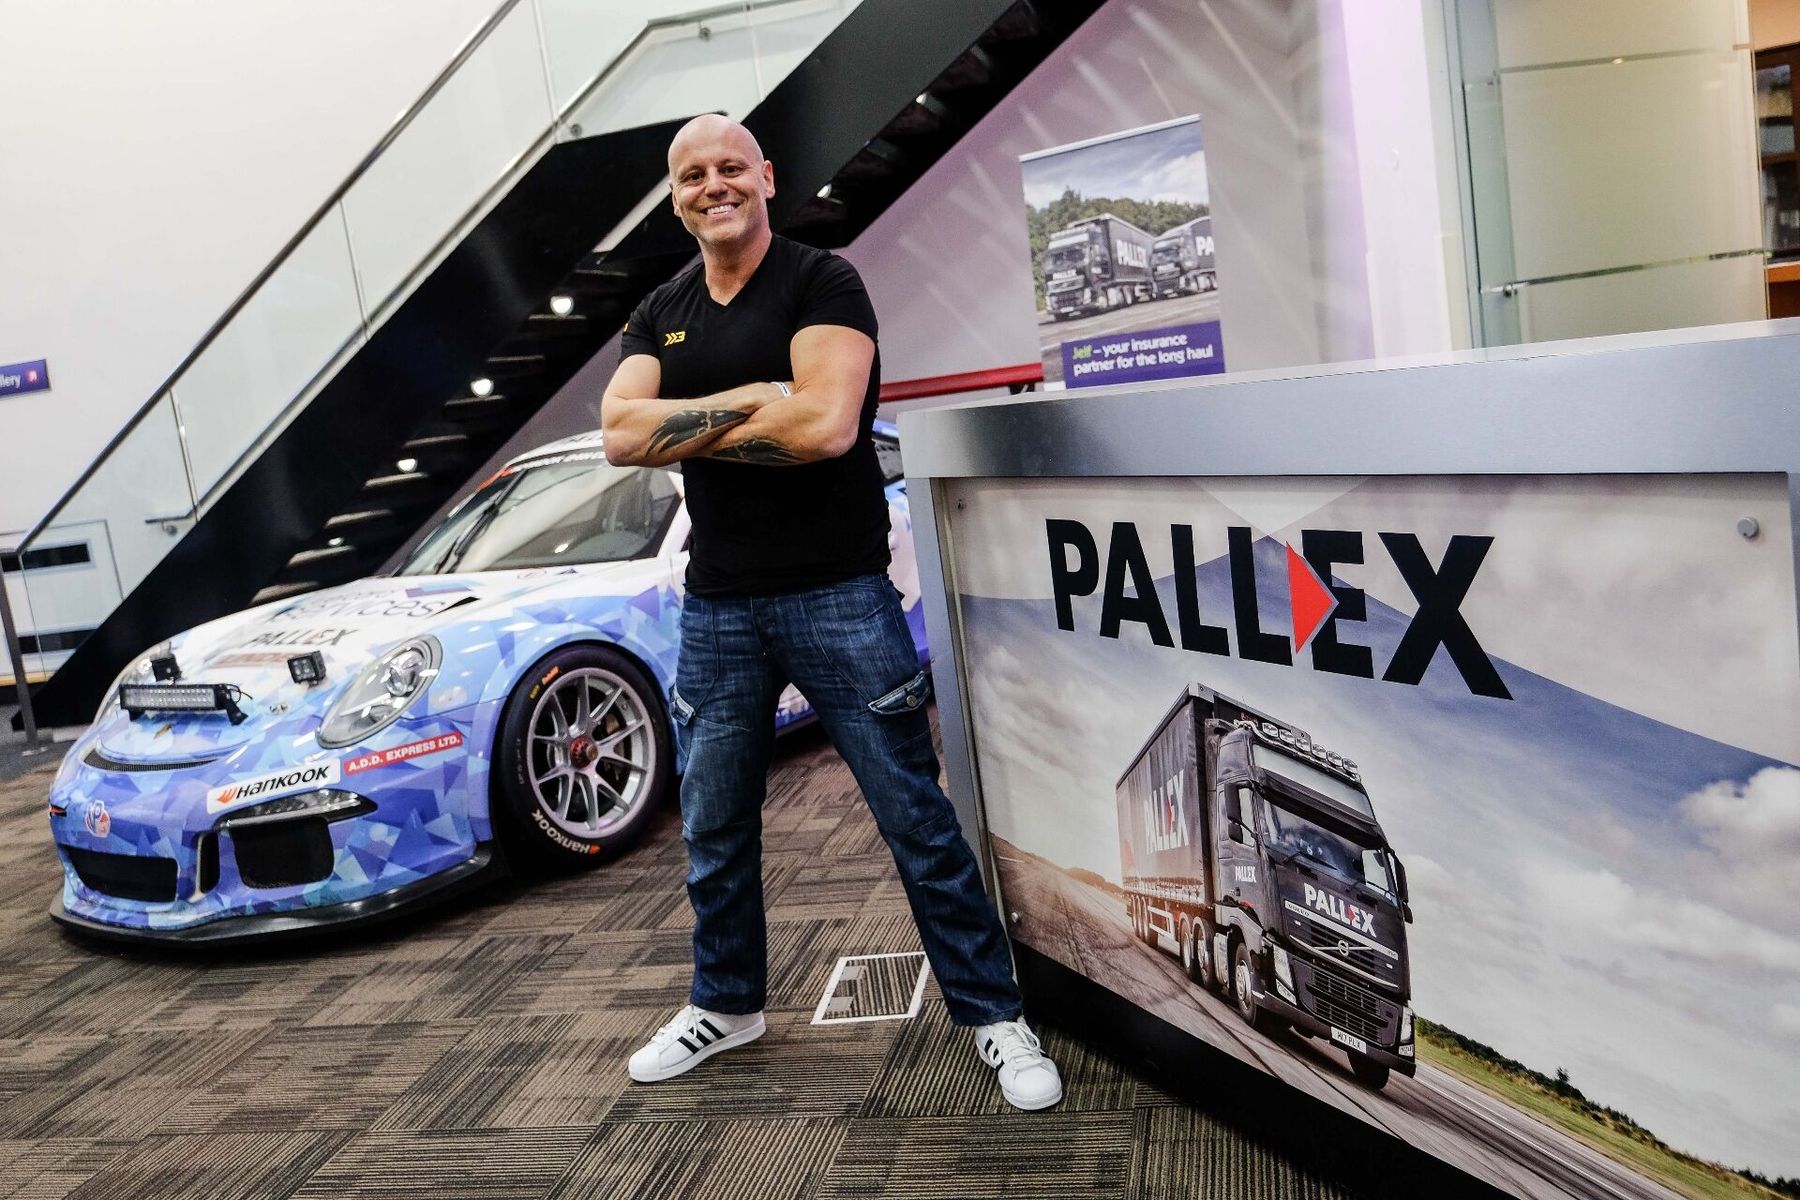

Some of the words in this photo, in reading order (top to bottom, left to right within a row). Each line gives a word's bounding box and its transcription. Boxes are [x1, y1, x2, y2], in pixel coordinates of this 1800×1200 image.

[1073, 359, 1115, 377] partner
[1116, 354, 1135, 369] for
[1136, 351, 1158, 366] the
[1158, 348, 1185, 364] long
[1186, 344, 1214, 360] haul
[1102, 341, 1131, 358] your
[1131, 334, 1188, 352] insurance
[1045, 518, 1514, 701] PALLEX
[349, 755, 384, 772] A.D.D.
[386, 742, 437, 761] EXPRESS
[438, 735, 461, 750] LTD.
[1304, 882, 1377, 938] PALLEX
